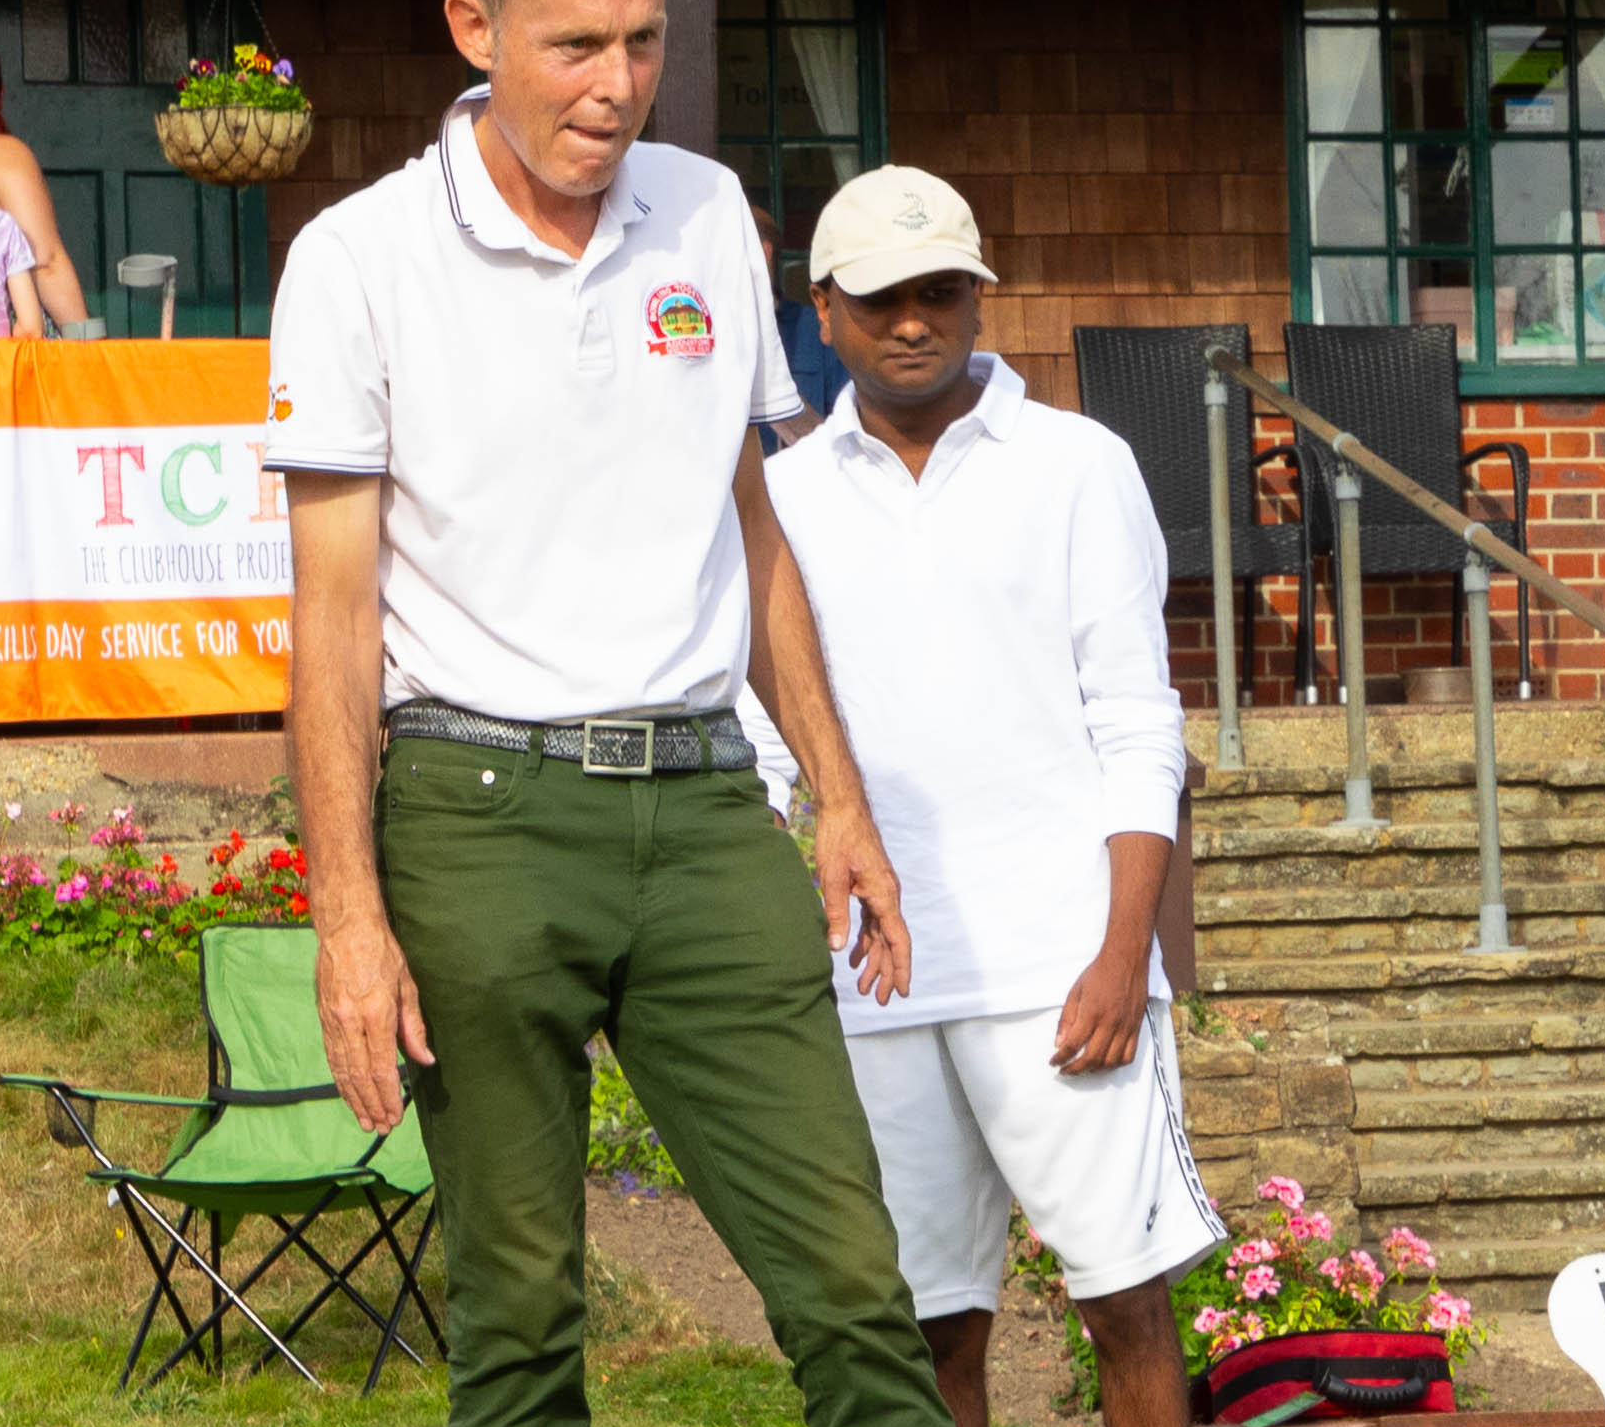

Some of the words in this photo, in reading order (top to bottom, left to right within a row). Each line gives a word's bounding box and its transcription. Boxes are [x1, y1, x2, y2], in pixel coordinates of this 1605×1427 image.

[82, 545, 108, 584] THE
[119, 542, 224, 584] CLUBHOUSE
[46, 622, 85, 660] DAY
[100, 621, 183, 659] SERVICE
[195, 620, 237, 656] FOR
